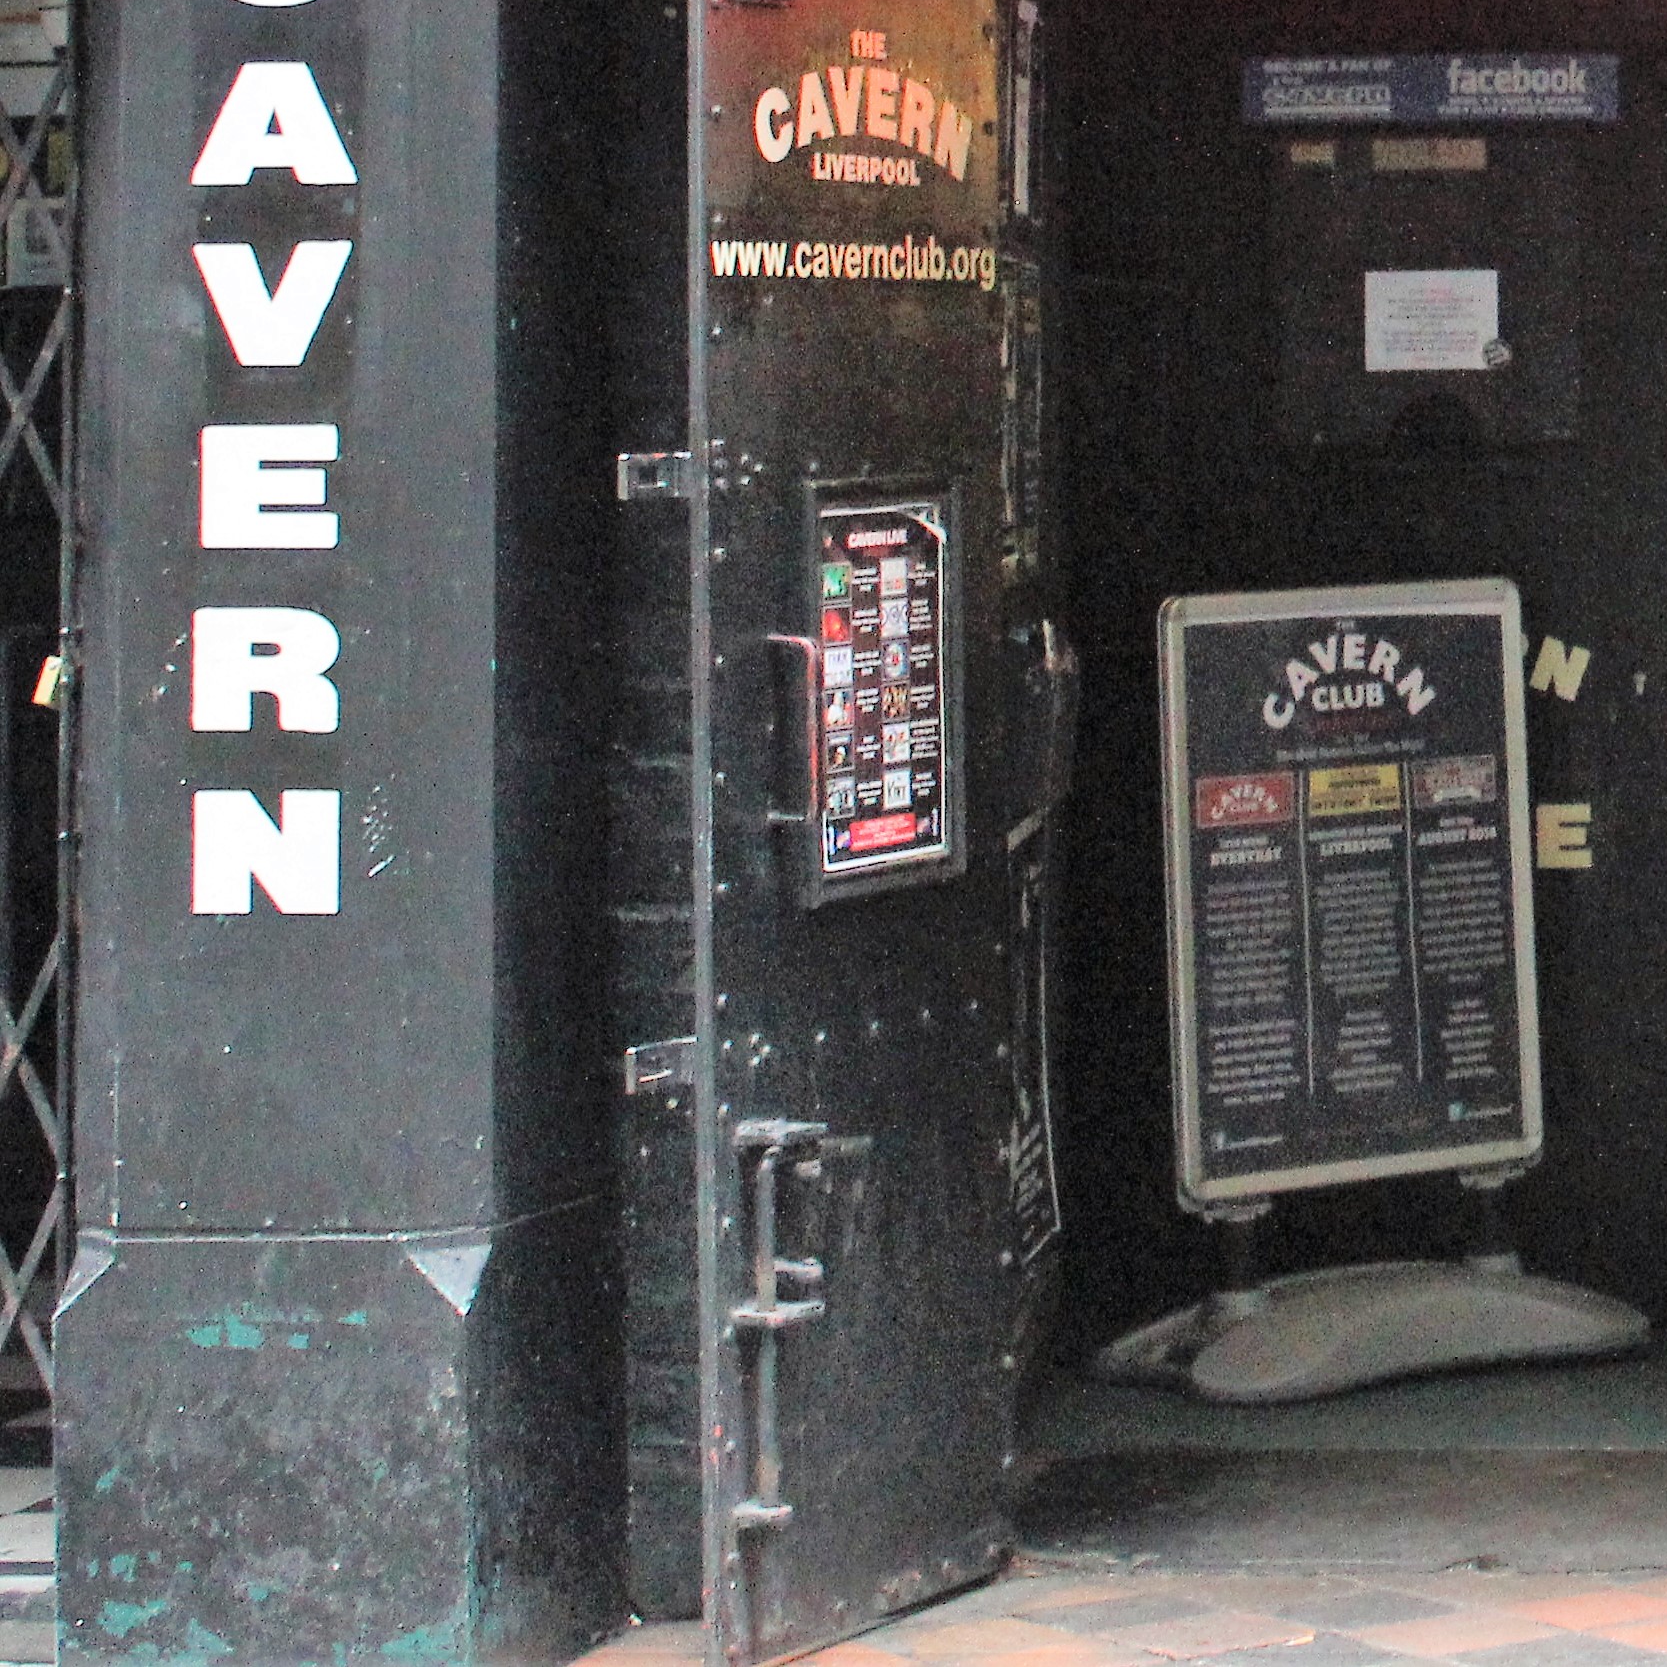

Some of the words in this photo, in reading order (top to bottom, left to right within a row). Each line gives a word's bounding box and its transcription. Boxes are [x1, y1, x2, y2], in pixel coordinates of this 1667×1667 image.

[851, 30, 887, 60] THE
[1447, 59, 1586, 94] facebook
[754, 66, 974, 182] CAVERN
[812, 152, 920, 185] LIVERPOOL
[711, 235, 997, 291] www.cavernclub.org
[1263, 633, 1436, 728] CAVERN
[1312, 682, 1385, 712] CLUB
[1211, 785, 1278, 820] CAVERN
